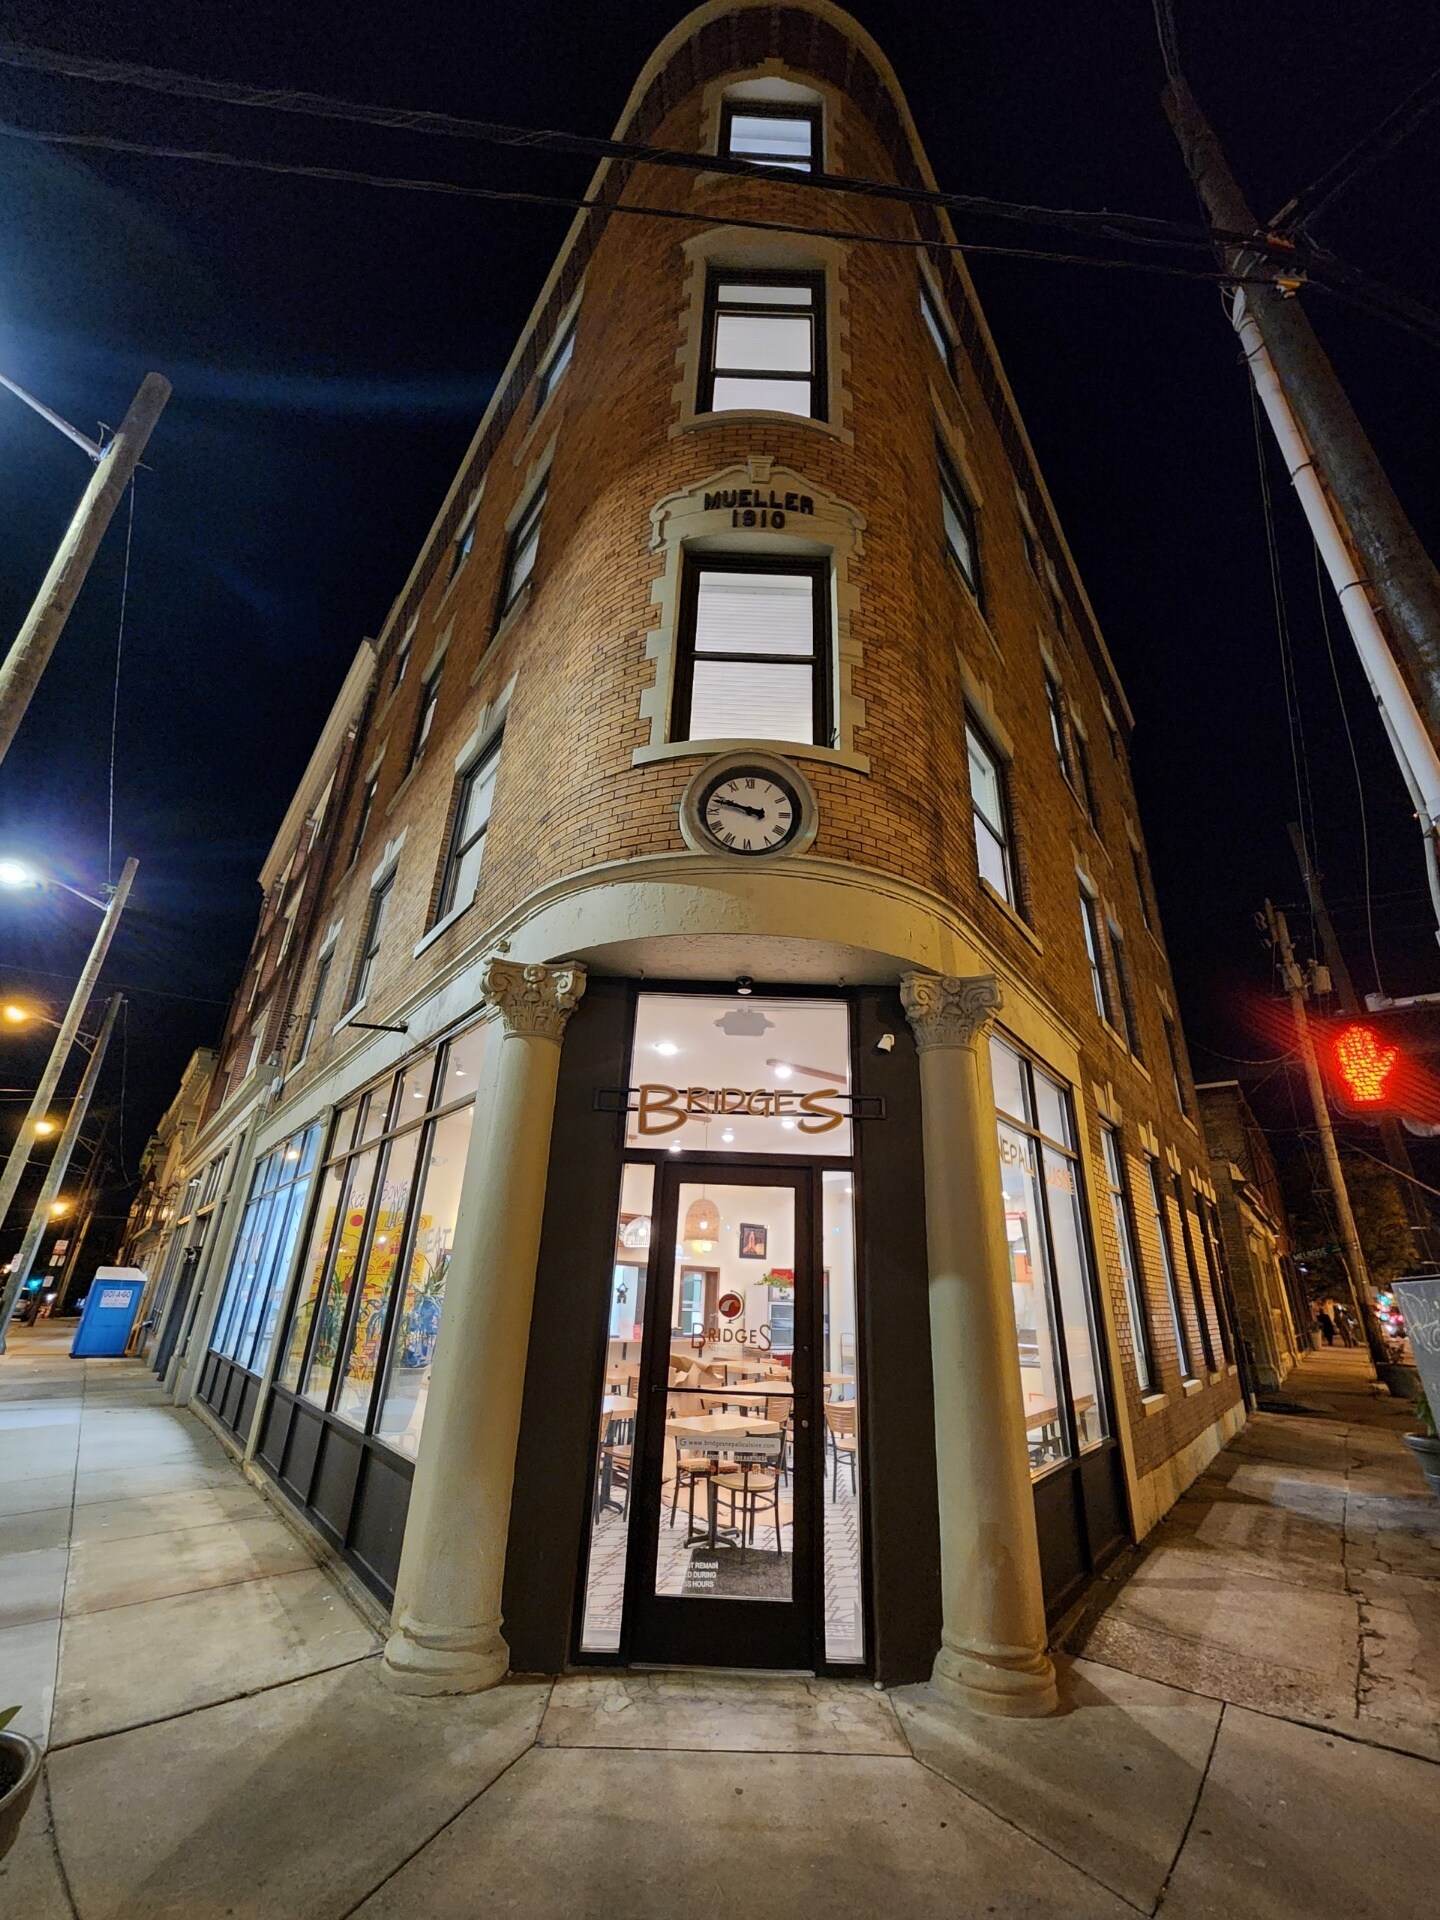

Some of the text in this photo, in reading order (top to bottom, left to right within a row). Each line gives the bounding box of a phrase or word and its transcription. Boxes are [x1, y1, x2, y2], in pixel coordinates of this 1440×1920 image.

[704, 489, 814, 515] MUELLER
[732, 509, 786, 529] 1910
[638, 1083, 844, 1135] BRIDGES
[691, 1322, 771, 1351] BRIDGES
[693, 1571, 717, 1579] DURING
[695, 1561, 718, 1569] REMAIN
[692, 1580, 714, 1588] HOURS
